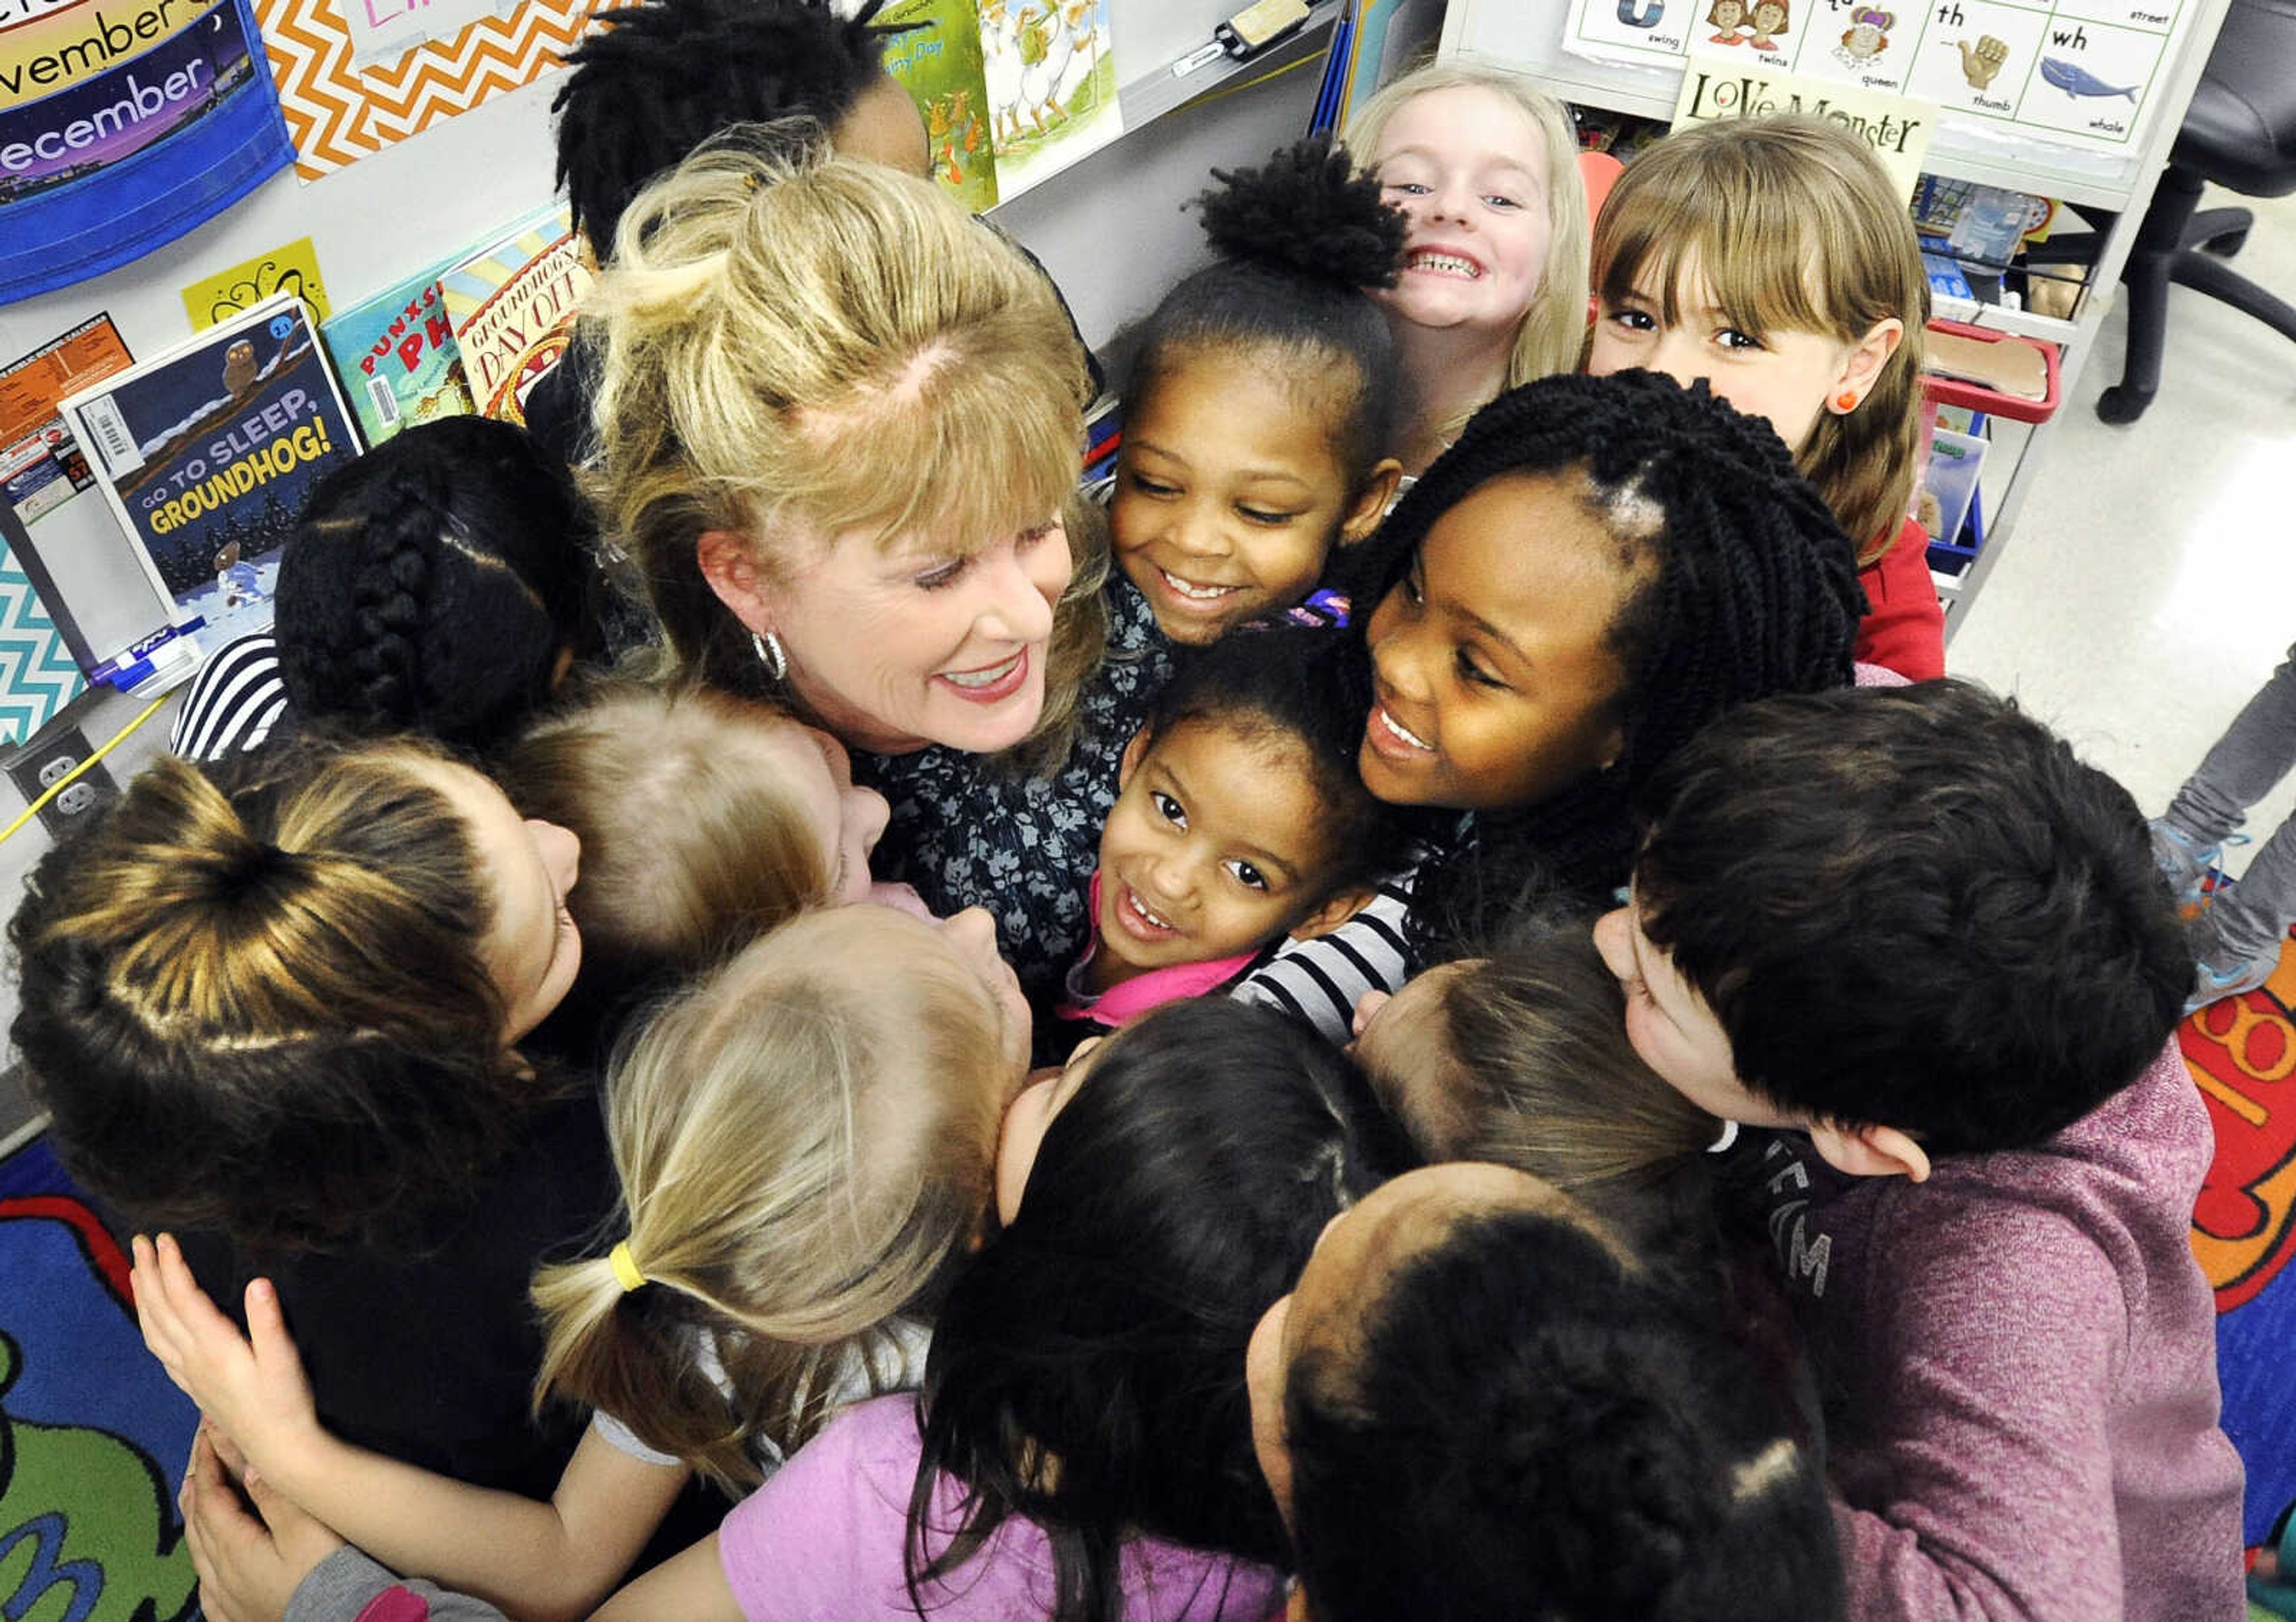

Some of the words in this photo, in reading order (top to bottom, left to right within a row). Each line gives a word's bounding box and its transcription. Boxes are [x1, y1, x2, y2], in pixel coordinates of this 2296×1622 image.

[1938, 3, 1965, 27] th
[2129, 10, 2170, 25] street
[1648, 35, 1680, 50] swing
[2052, 26, 2088, 50] wh
[1758, 53, 1788, 67] twins
[1861, 75, 1899, 89] queen
[1973, 95, 2011, 112] thumb
[2089, 118, 2124, 134] whale
[360, 283, 443, 376] PUNXS
[474, 309, 527, 393] DAY
[532, 266, 578, 328] OFF
[142, 487, 168, 509] GO
[169, 459, 207, 488] TO
[210, 388, 317, 465] SLEEP,
[150, 416, 332, 534] GROUNDHOG!
